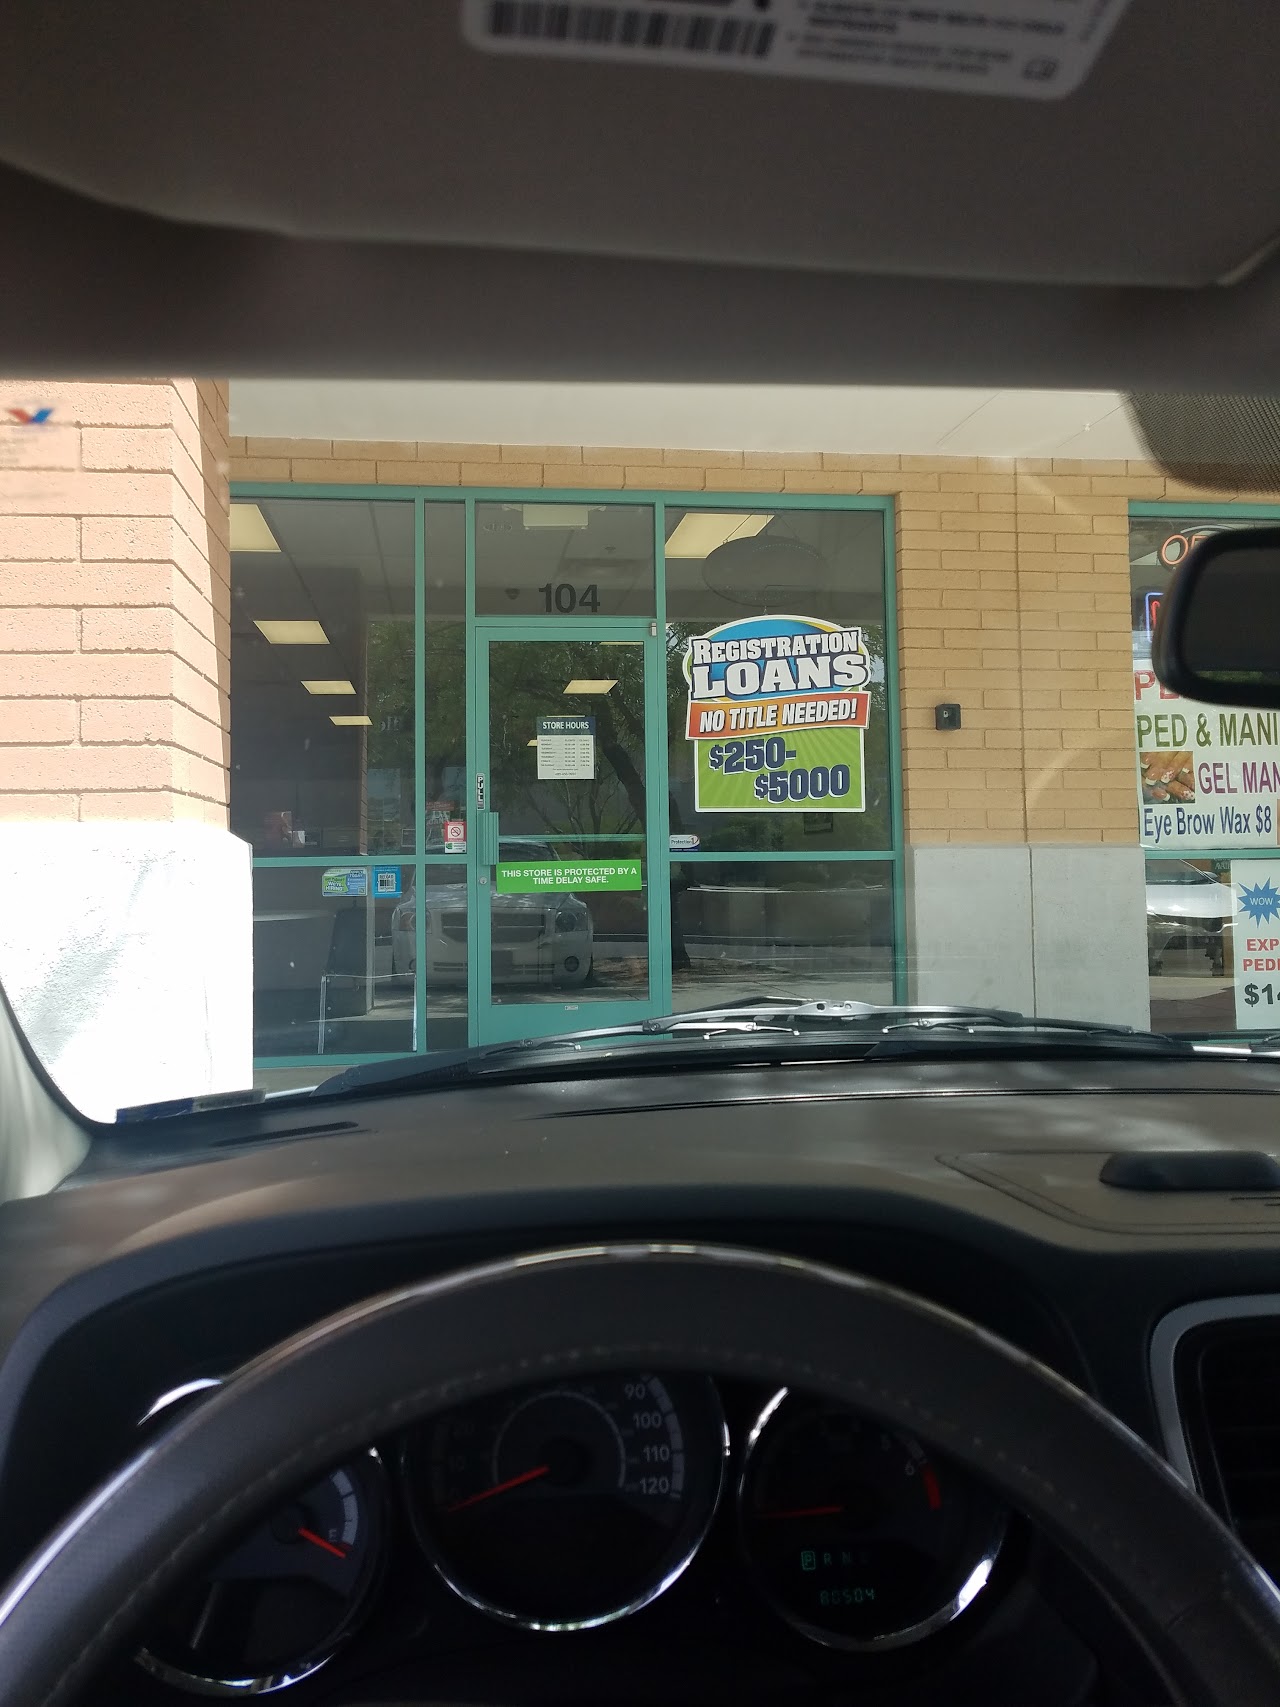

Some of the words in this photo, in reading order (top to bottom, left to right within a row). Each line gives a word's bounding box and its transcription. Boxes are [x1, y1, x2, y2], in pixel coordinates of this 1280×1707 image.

[538, 583, 600, 613] 104
[693, 631, 859, 664] REGISTRATION
[693, 654, 867, 699] LOANS
[542, 721, 565, 729] STORE
[566, 721, 590, 729] HOURS
[699, 710, 725, 733] NO
[729, 704, 778, 730] TITLE
[781, 698, 857, 726] NEEDED!
[1136, 714, 1188, 748] PED
[1196, 713, 1212, 747] &
[709, 737, 797, 775] $250-
[754, 764, 851, 804] $5000
[1198, 762, 1238, 794] GEL
[1143, 807, 1172, 843] Eye
[1176, 807, 1215, 835] Brow
[1219, 806, 1251, 834] Wax
[1255, 804, 1272, 837] $8
[501, 869, 521, 877] THIS
[523, 869, 552, 877] STORE
[564, 868, 615, 876] PROTECTED
[617, 867, 629, 875] BY
[533, 877, 554, 885] TIME
[555, 876, 583, 884] DELAY
[1250, 897, 1274, 906] WOW
[624, 1383, 647, 1399] 90
[632, 1411, 662, 1428] 100
[643, 1446, 670, 1462] 110
[639, 1477, 670, 1494] 120
[823, 1552, 832, 1566] R
